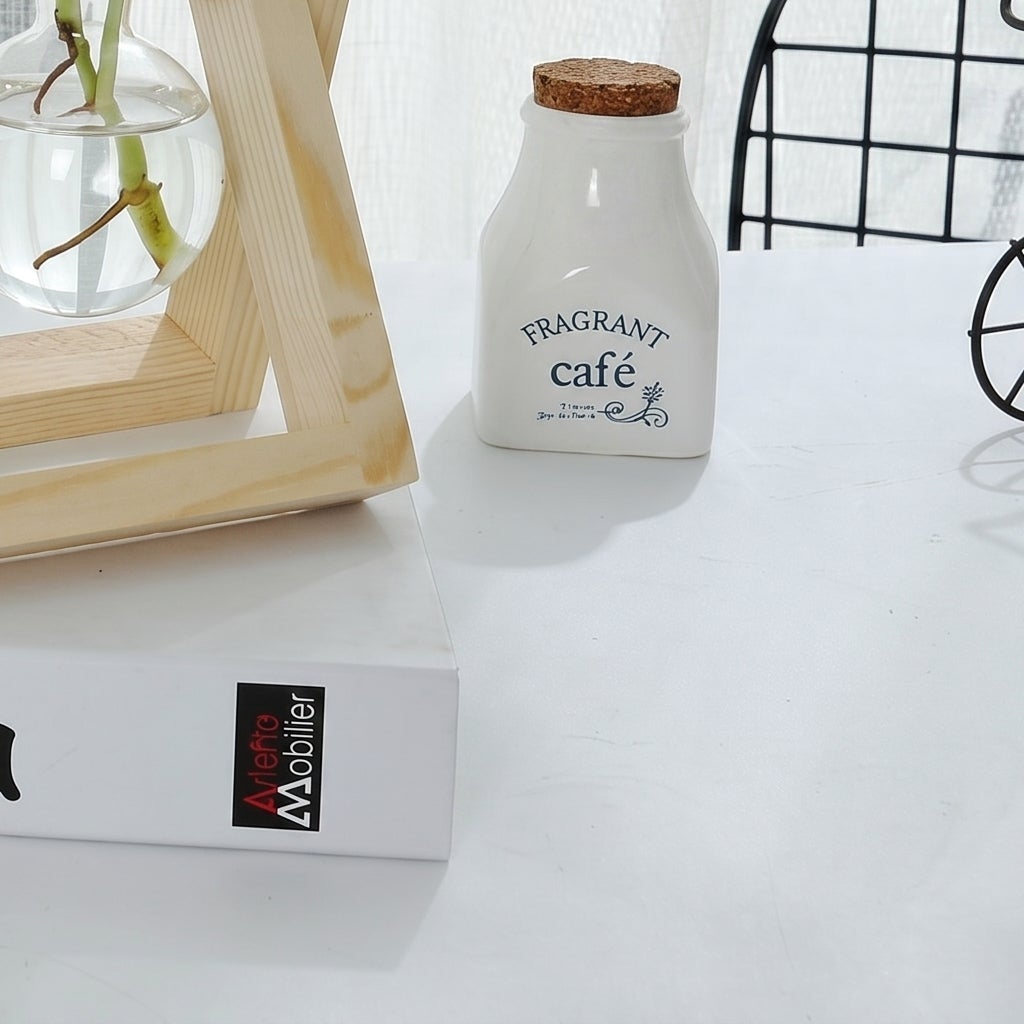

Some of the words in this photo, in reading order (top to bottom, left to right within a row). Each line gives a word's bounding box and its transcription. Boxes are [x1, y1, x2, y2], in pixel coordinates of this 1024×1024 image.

[520, 310, 670, 349] FRAGRANT
[550, 350, 636, 388] café
[277, 692, 315, 828] Mobilier
